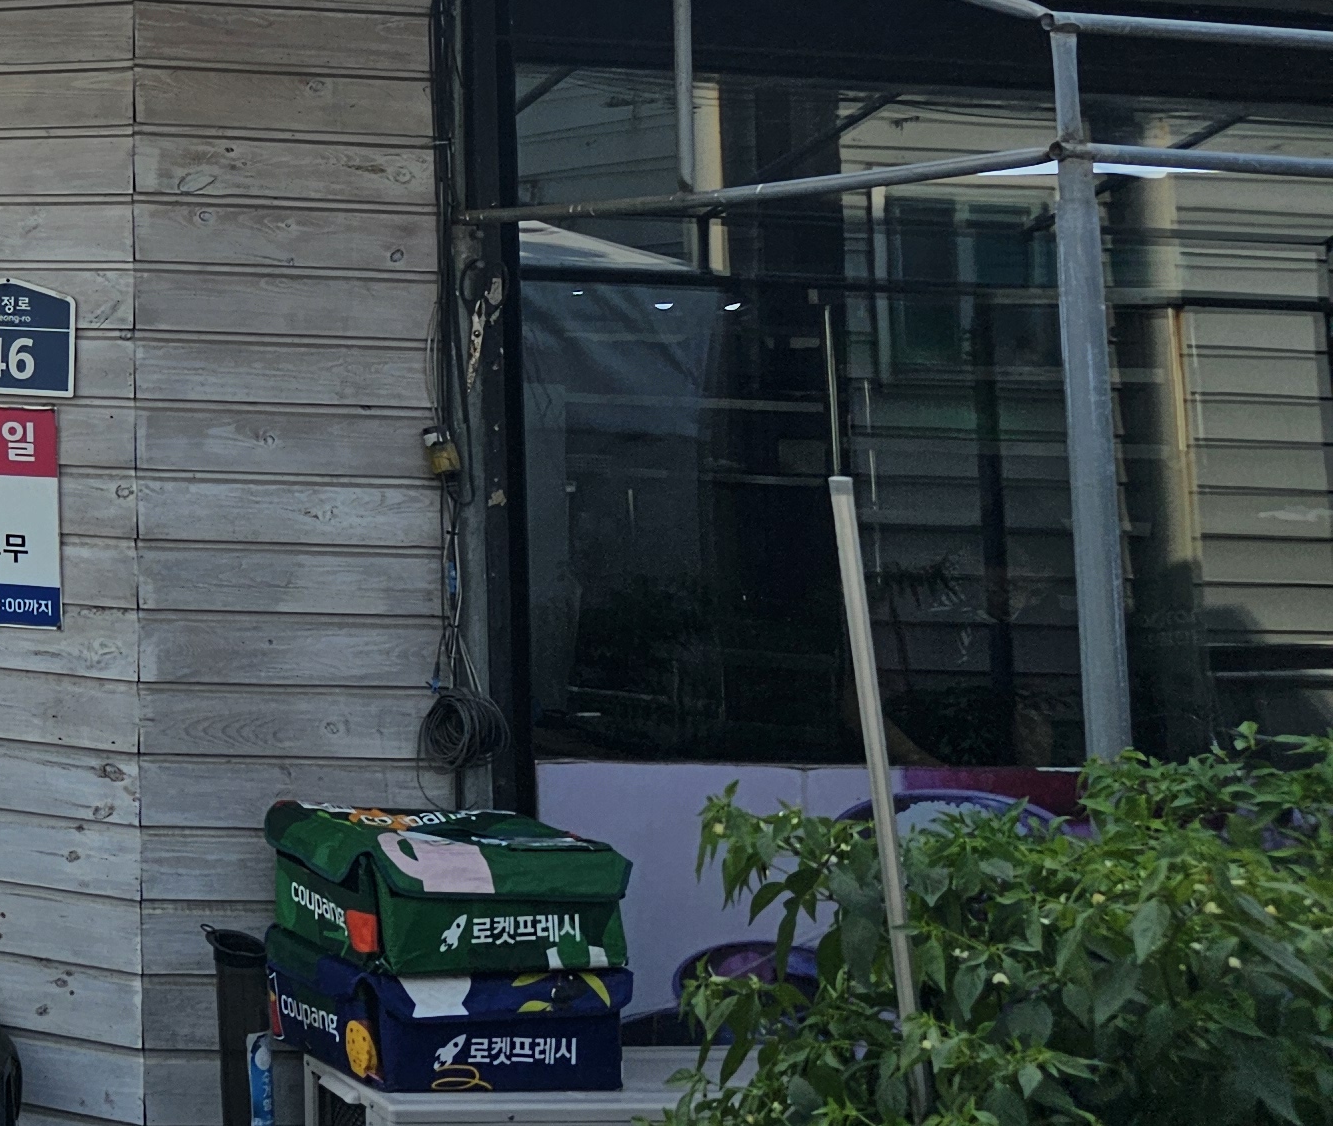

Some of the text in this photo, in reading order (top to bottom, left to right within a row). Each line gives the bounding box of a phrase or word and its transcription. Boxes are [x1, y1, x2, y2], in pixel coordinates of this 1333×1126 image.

[291, 881, 348, 936] coupang
[470, 914, 581, 946] 로켓프레시
[280, 992, 339, 1043] coupang
[468, 1037, 577, 1067] 로켓프레시
